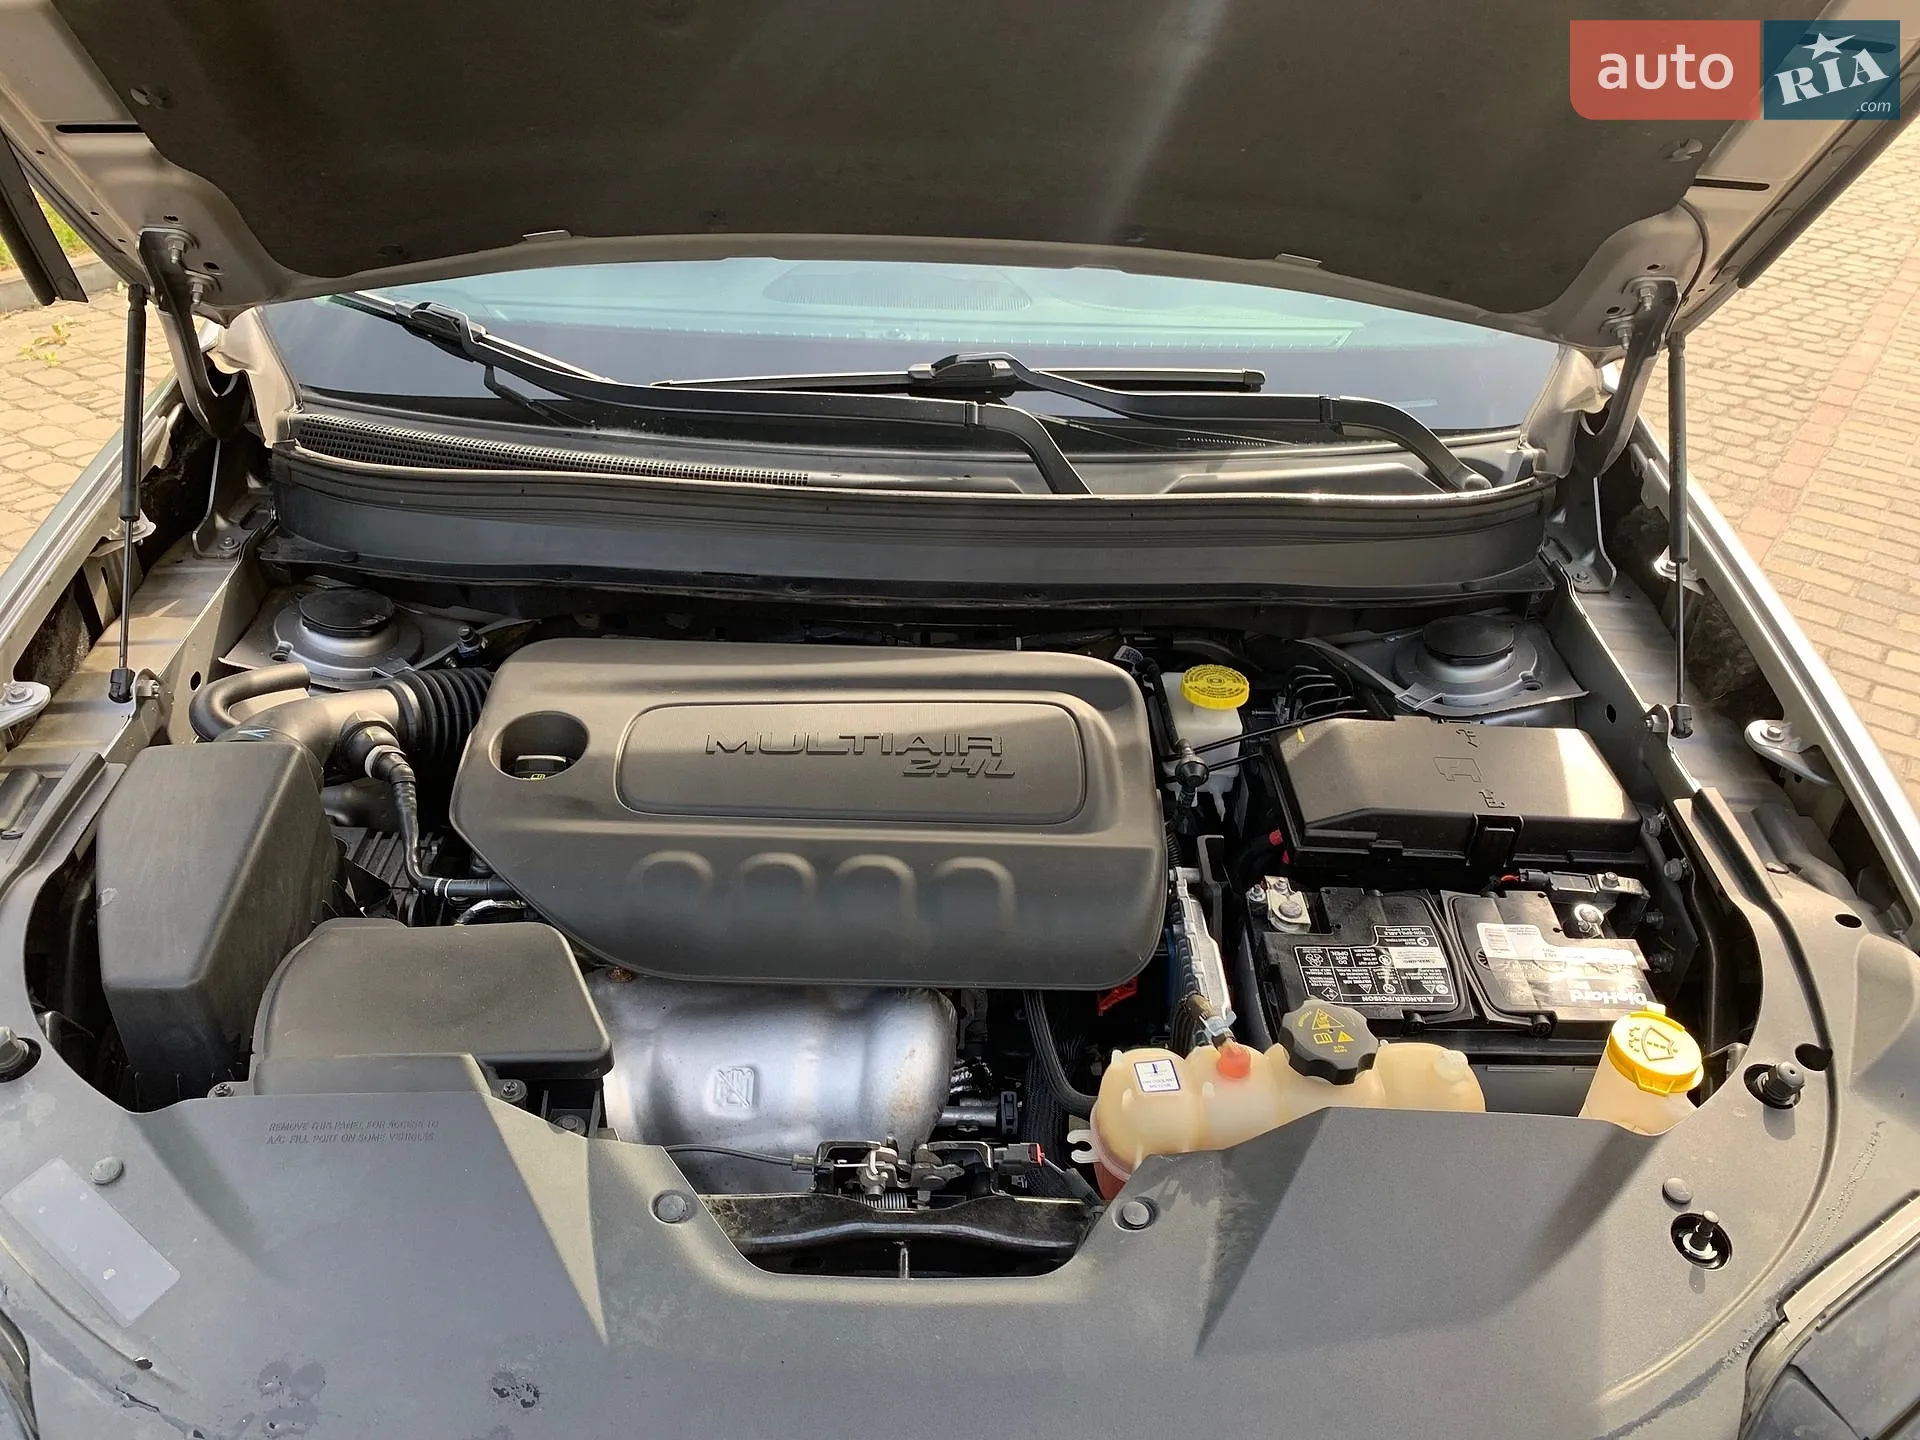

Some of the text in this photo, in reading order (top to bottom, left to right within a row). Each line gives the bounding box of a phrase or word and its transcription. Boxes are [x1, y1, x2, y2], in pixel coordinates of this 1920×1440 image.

[704, 731, 1003, 757] MULTIAIR
[902, 758, 1016, 778] 2.4L
[1571, 990, 1648, 1005] DieHard
